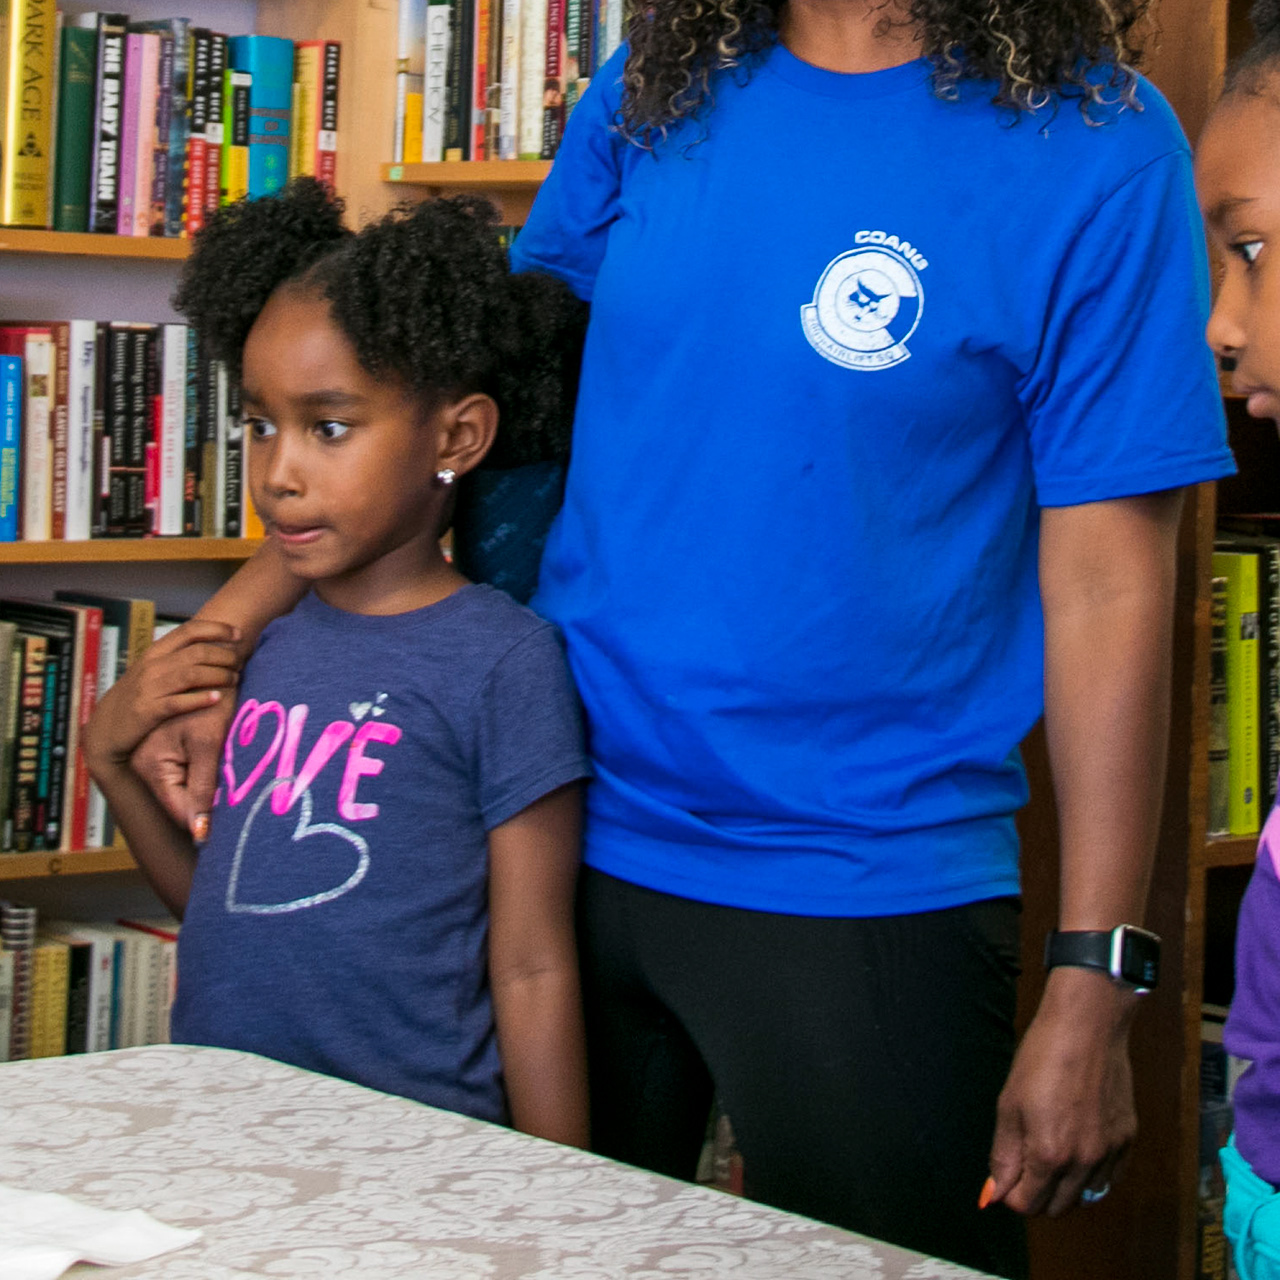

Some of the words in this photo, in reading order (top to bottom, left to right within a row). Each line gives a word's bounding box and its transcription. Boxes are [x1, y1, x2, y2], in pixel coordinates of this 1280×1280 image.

[103, 37, 122, 74] THE
[428, 15, 446, 125] CHEKHOV
[545, 30, 560, 76] ANGELS
[21, 65, 43, 121] AGE
[101, 78, 120, 136] BABY
[98, 140, 117, 201] TRAIN
[113, 333, 127, 381] Running
[132, 333, 146, 383] Running
[113, 384, 127, 411] with
[132, 385, 146, 412] with
[112, 414, 128, 460] Scissors
[226, 449, 241, 507] Kindred
[212, 698, 403, 821] OVE
